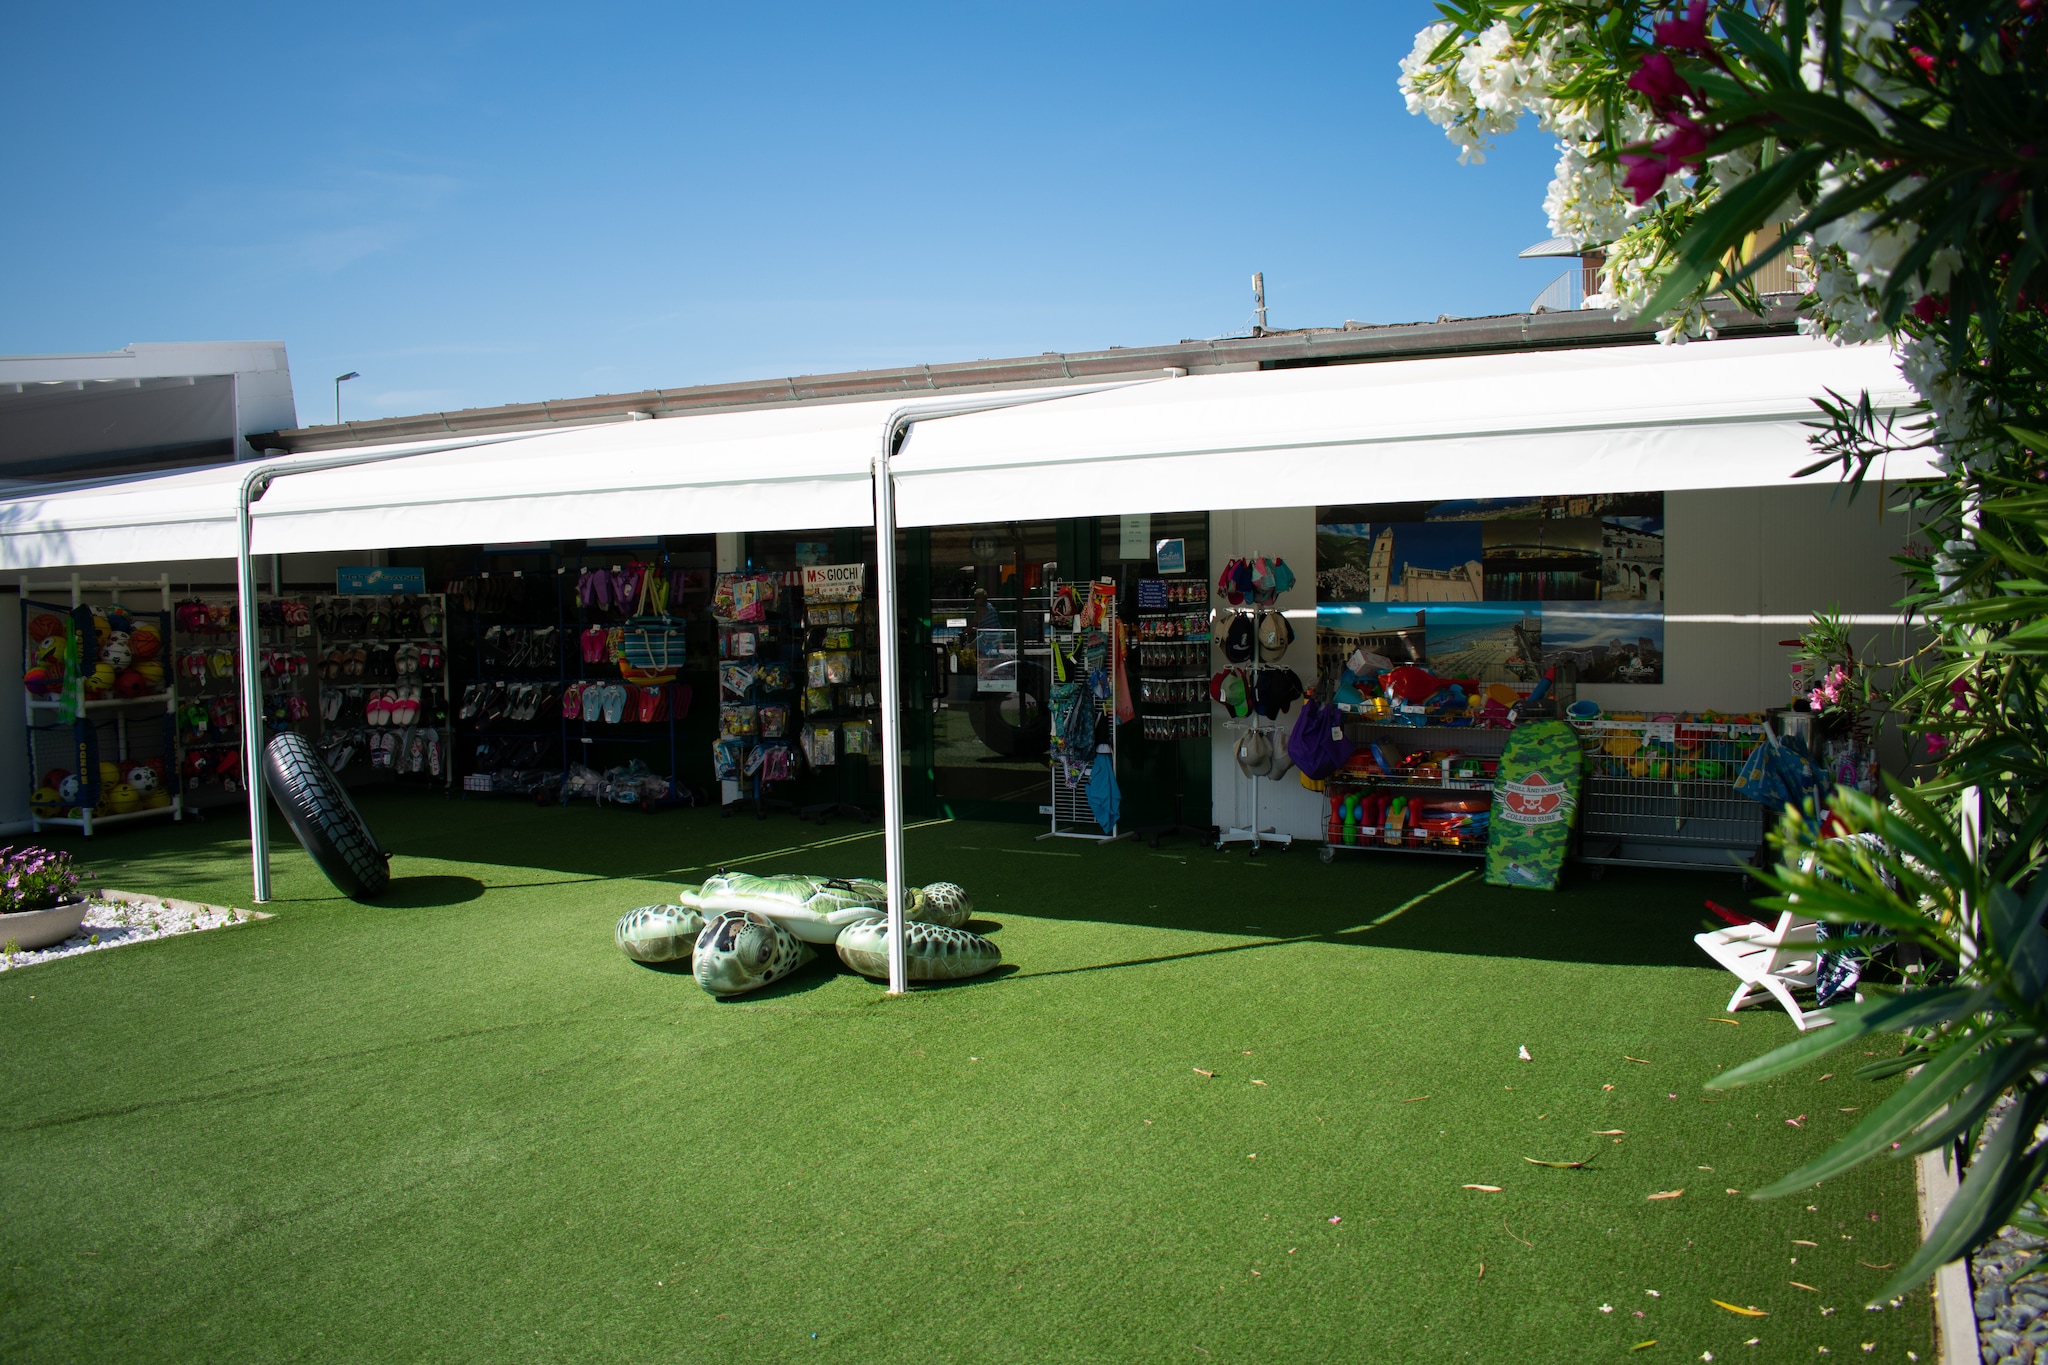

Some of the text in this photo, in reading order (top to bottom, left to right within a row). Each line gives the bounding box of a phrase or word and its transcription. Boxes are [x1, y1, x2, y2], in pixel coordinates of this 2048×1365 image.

[828, 567, 858, 581] GIOCHI
[79, 742, 88, 785] MONDO
[1508, 784, 1525, 792] SKULL
[1541, 785, 1562, 793] BONES
[1505, 812, 1555, 822] COLLEGE SURF
